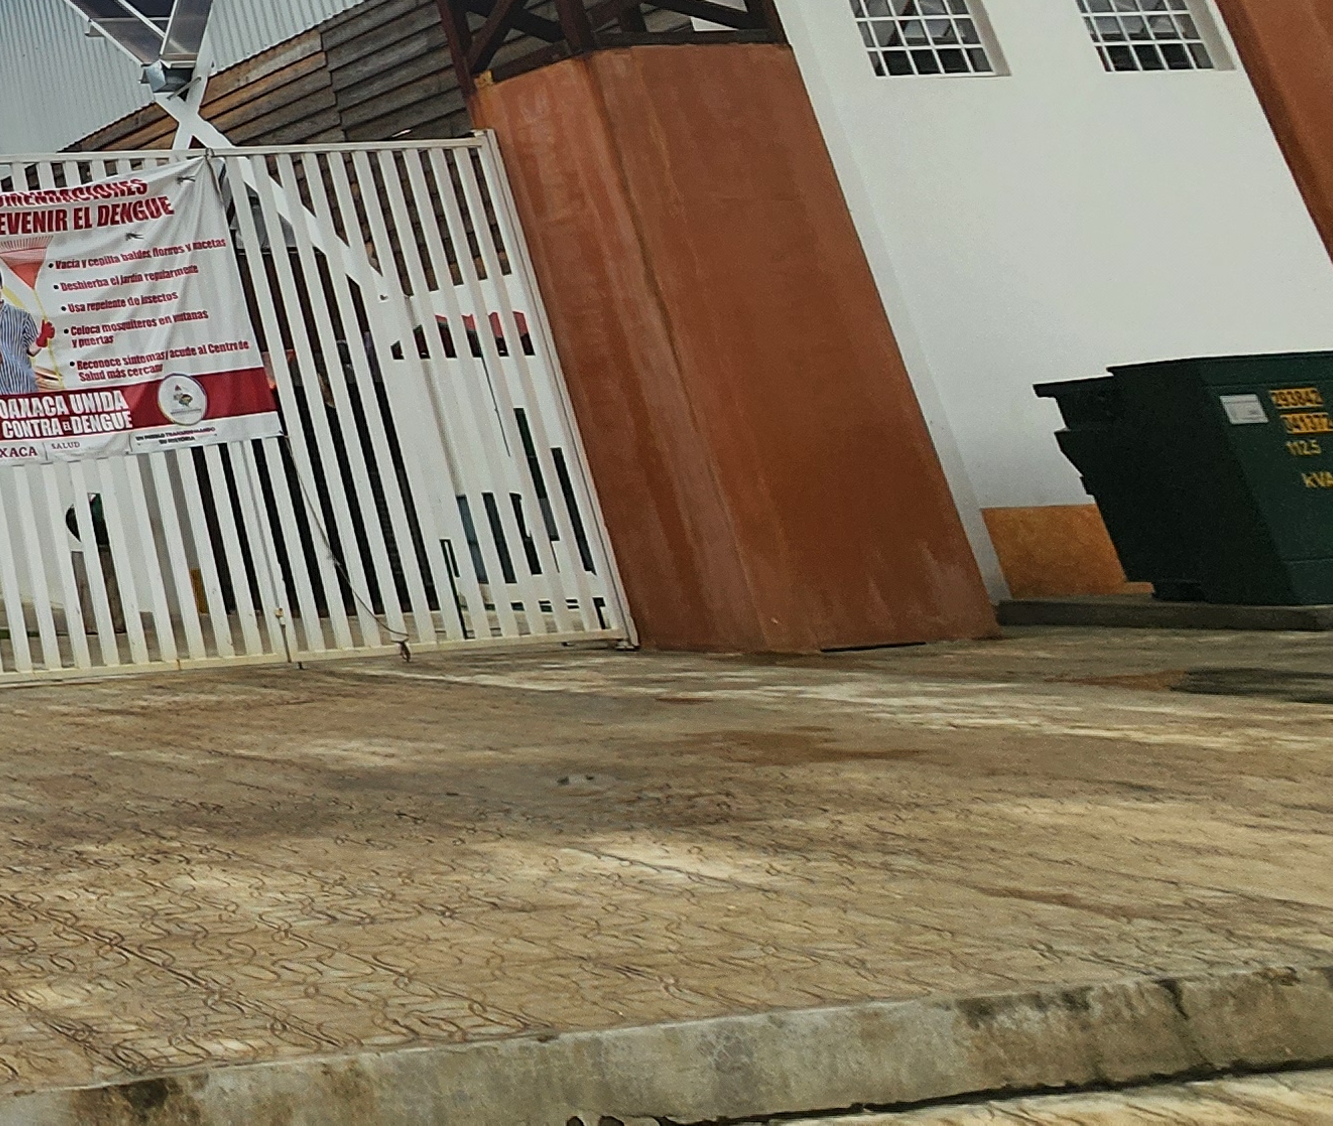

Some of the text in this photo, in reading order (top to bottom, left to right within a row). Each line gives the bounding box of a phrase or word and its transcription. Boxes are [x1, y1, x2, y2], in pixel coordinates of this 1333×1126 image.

[73, 206, 93, 230] EL
[97, 196, 175, 228] DENGUE
[88, 256, 120, 266] cepilla
[60, 278, 109, 291] Deshierba
[110, 275, 119, 285] el
[68, 291, 179, 312] Usa repelente de insectos
[70, 325, 100, 336] Coloca
[102, 317, 157, 333] mosquiteros
[159, 315, 172, 325] en
[71, 335, 114, 348] y puertas
[76, 356, 121, 370] Reconoce
[198, 345, 207, 355] al
[238, 340, 250, 350] de
[79, 368, 105, 382] Salud
[107, 368, 127, 379] más
[70, 390, 130, 415] UNIDA
[2, 417, 65, 439] CONTRA
[71, 411, 133, 434] DENGUE
[51, 440, 81, 450] SALUD
